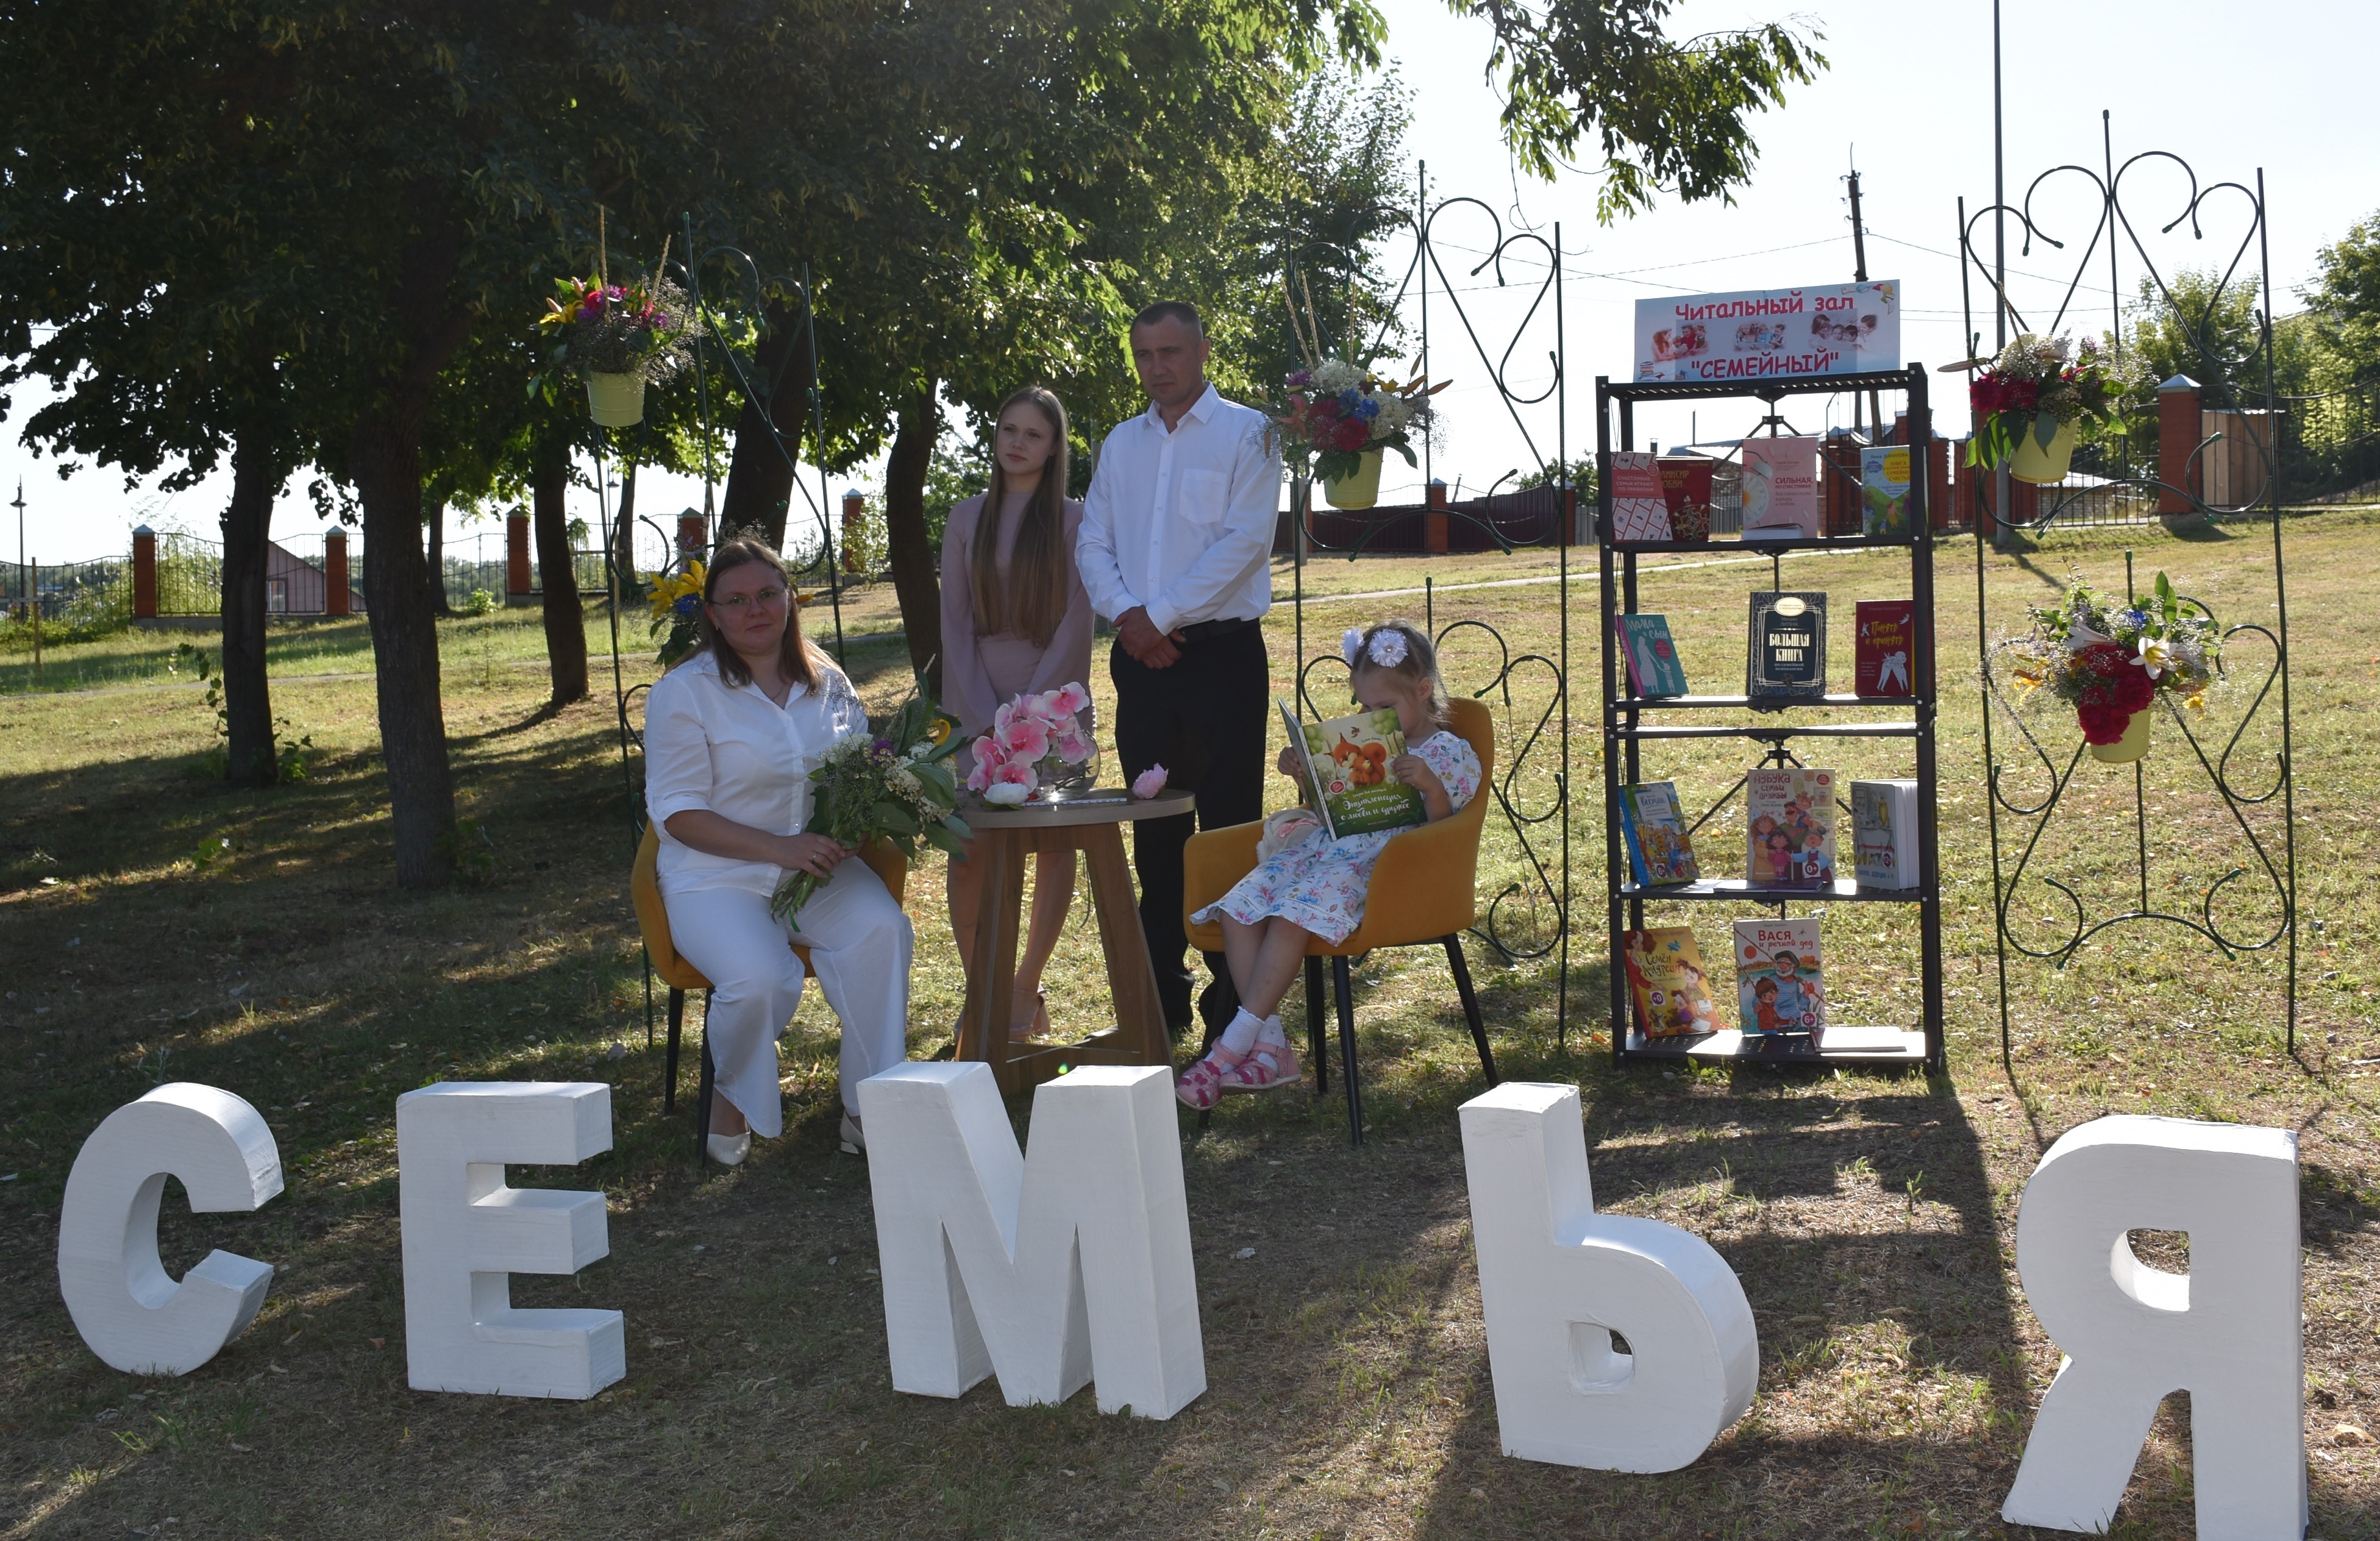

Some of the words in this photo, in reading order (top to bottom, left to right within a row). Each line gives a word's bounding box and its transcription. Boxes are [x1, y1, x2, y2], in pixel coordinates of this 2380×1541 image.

[1675, 290, 1803, 320] Читальный
[1815, 296, 1854, 311] зал
[1691, 347, 1839, 379] "СЕМЕЙНЫЙ"
[1660, 470, 1690, 479] ЛИКСИР
[1769, 633, 1809, 647] БОЛЬШАЯ
[1775, 649, 1803, 662] КНИГА
[1343, 794, 1402, 810] Энциклопедия
[1768, 939, 1796, 951] речной
[1799, 940, 1813, 950] дед
[1805, 1015, 1814, 1023] 6+
